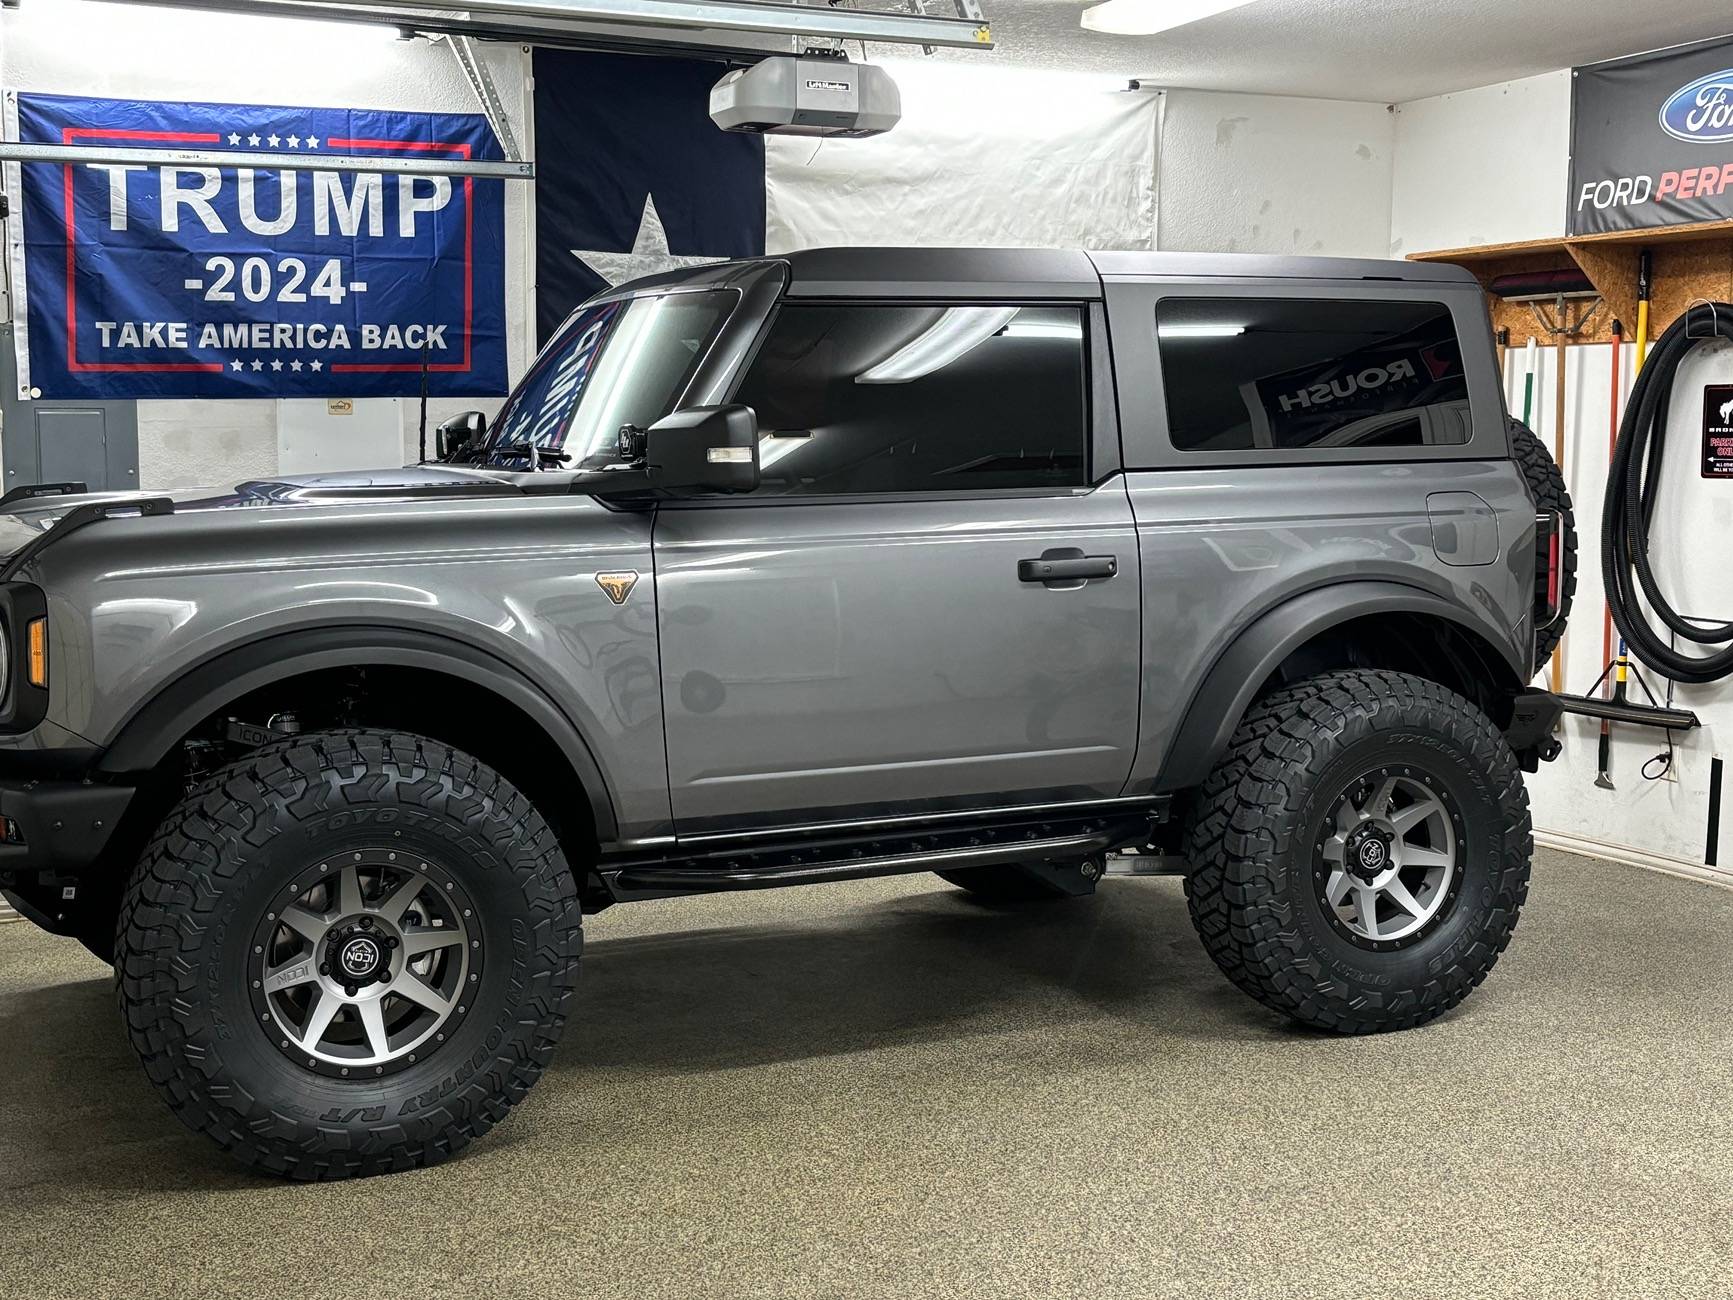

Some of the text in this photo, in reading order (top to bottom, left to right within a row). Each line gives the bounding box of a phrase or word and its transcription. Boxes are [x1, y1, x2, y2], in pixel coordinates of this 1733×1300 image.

[86, 163, 452, 238] TRUMP
[1577, 175, 1653, 212] FORD
[95, 321, 448, 350] TAKE AMERICA BACK
[239, 727, 272, 745] ICON
[305, 807, 400, 841] TOYO
[346, 951, 374, 963] ICON
[318, 1105, 387, 1123] R/T
